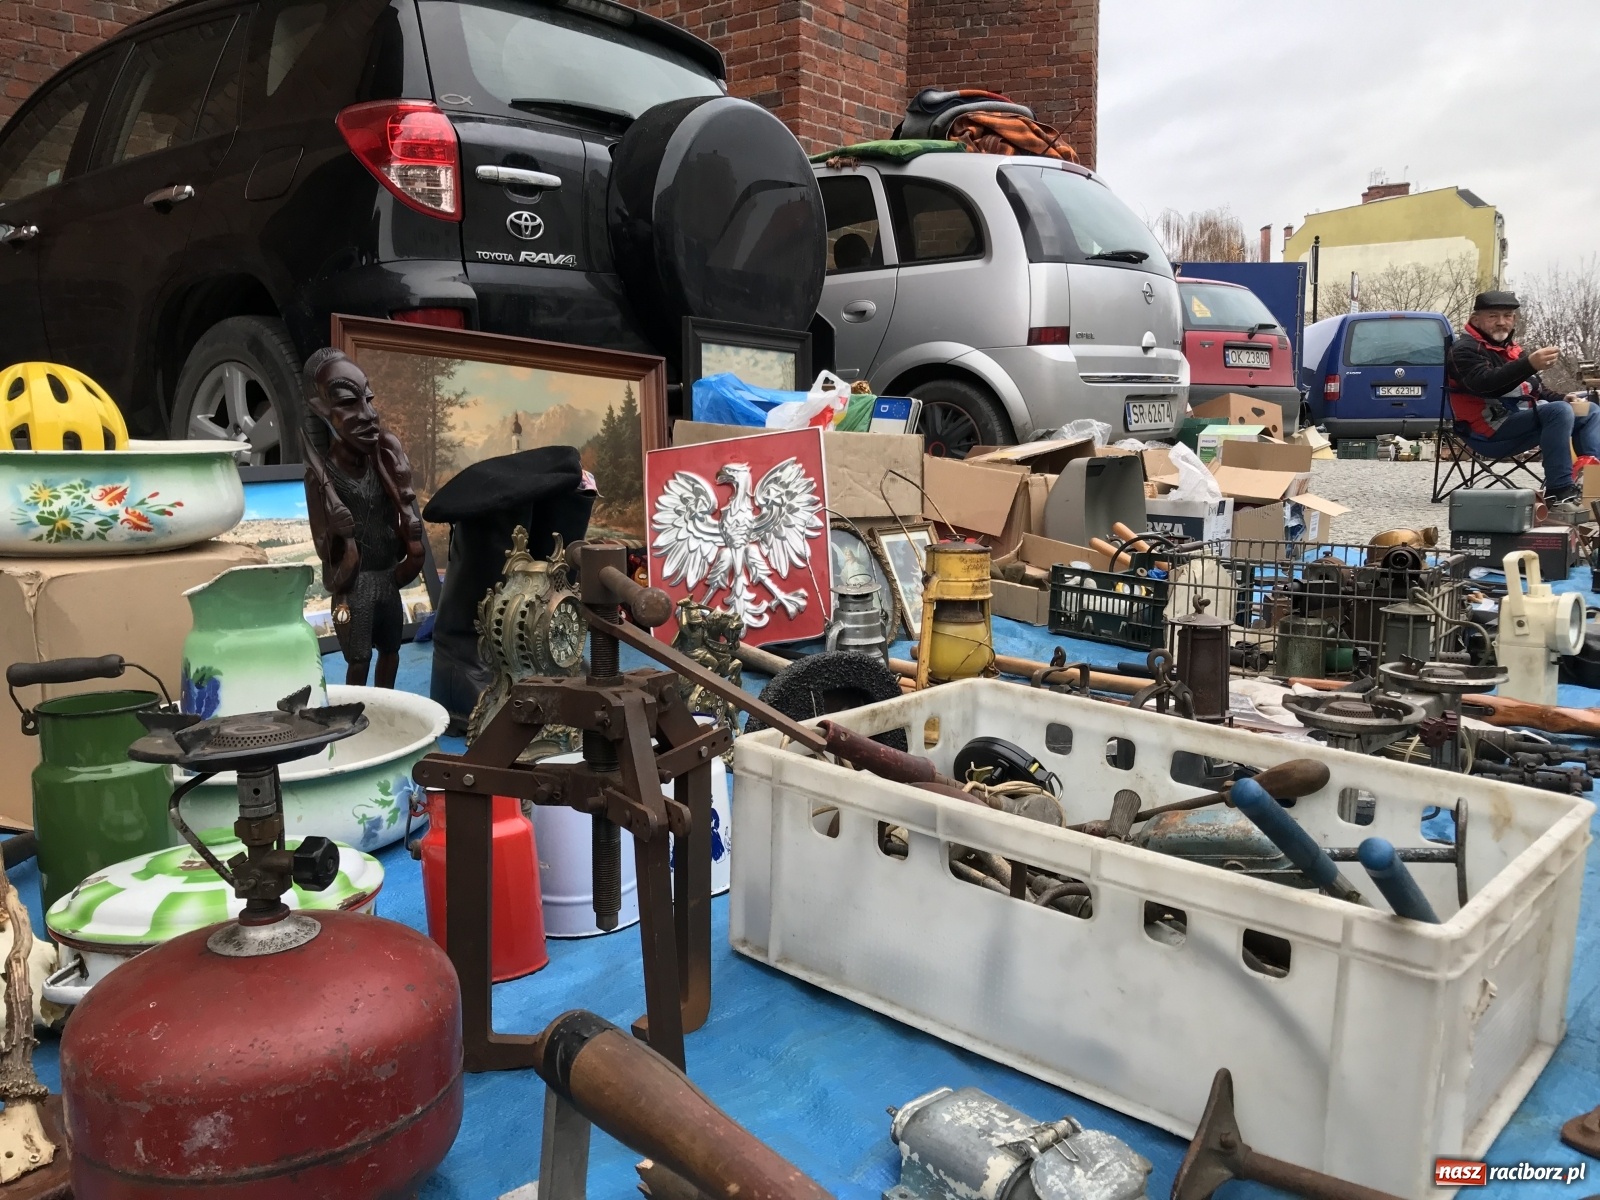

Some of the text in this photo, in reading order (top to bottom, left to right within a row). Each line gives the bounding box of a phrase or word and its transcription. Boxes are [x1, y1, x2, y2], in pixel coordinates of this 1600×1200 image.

[476, 251, 577, 267] TOYOTA RAV4
[1230, 350, 1269, 364] OK 23800
[1381, 387, 1420, 395] SK 623HJ
[1132, 404, 1146, 423] SR
